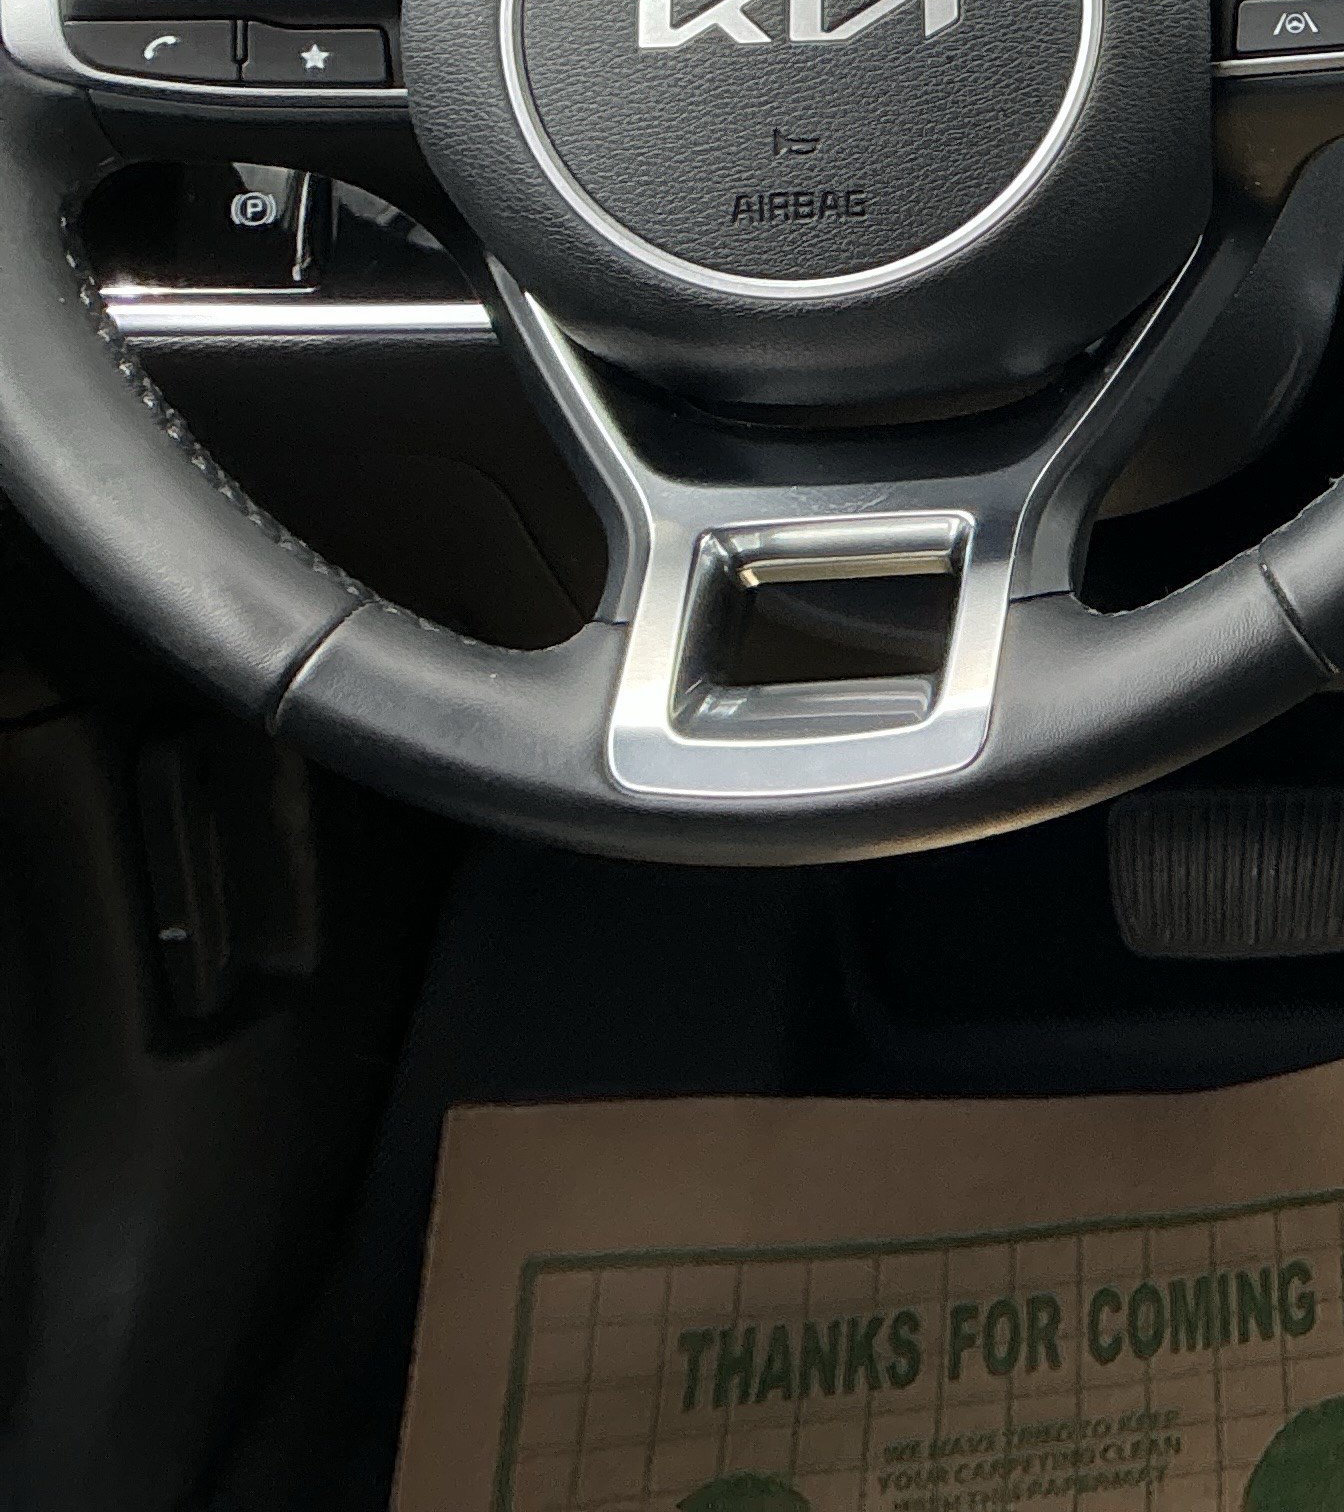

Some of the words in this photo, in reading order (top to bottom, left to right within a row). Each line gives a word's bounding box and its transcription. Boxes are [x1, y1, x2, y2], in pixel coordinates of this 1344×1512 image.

[730, 189, 868, 223] AIRBAG
[677, 1307, 922, 1412] THANKS
[946, 1291, 1063, 1382] FOR
[1085, 1258, 1318, 1366] COMING
